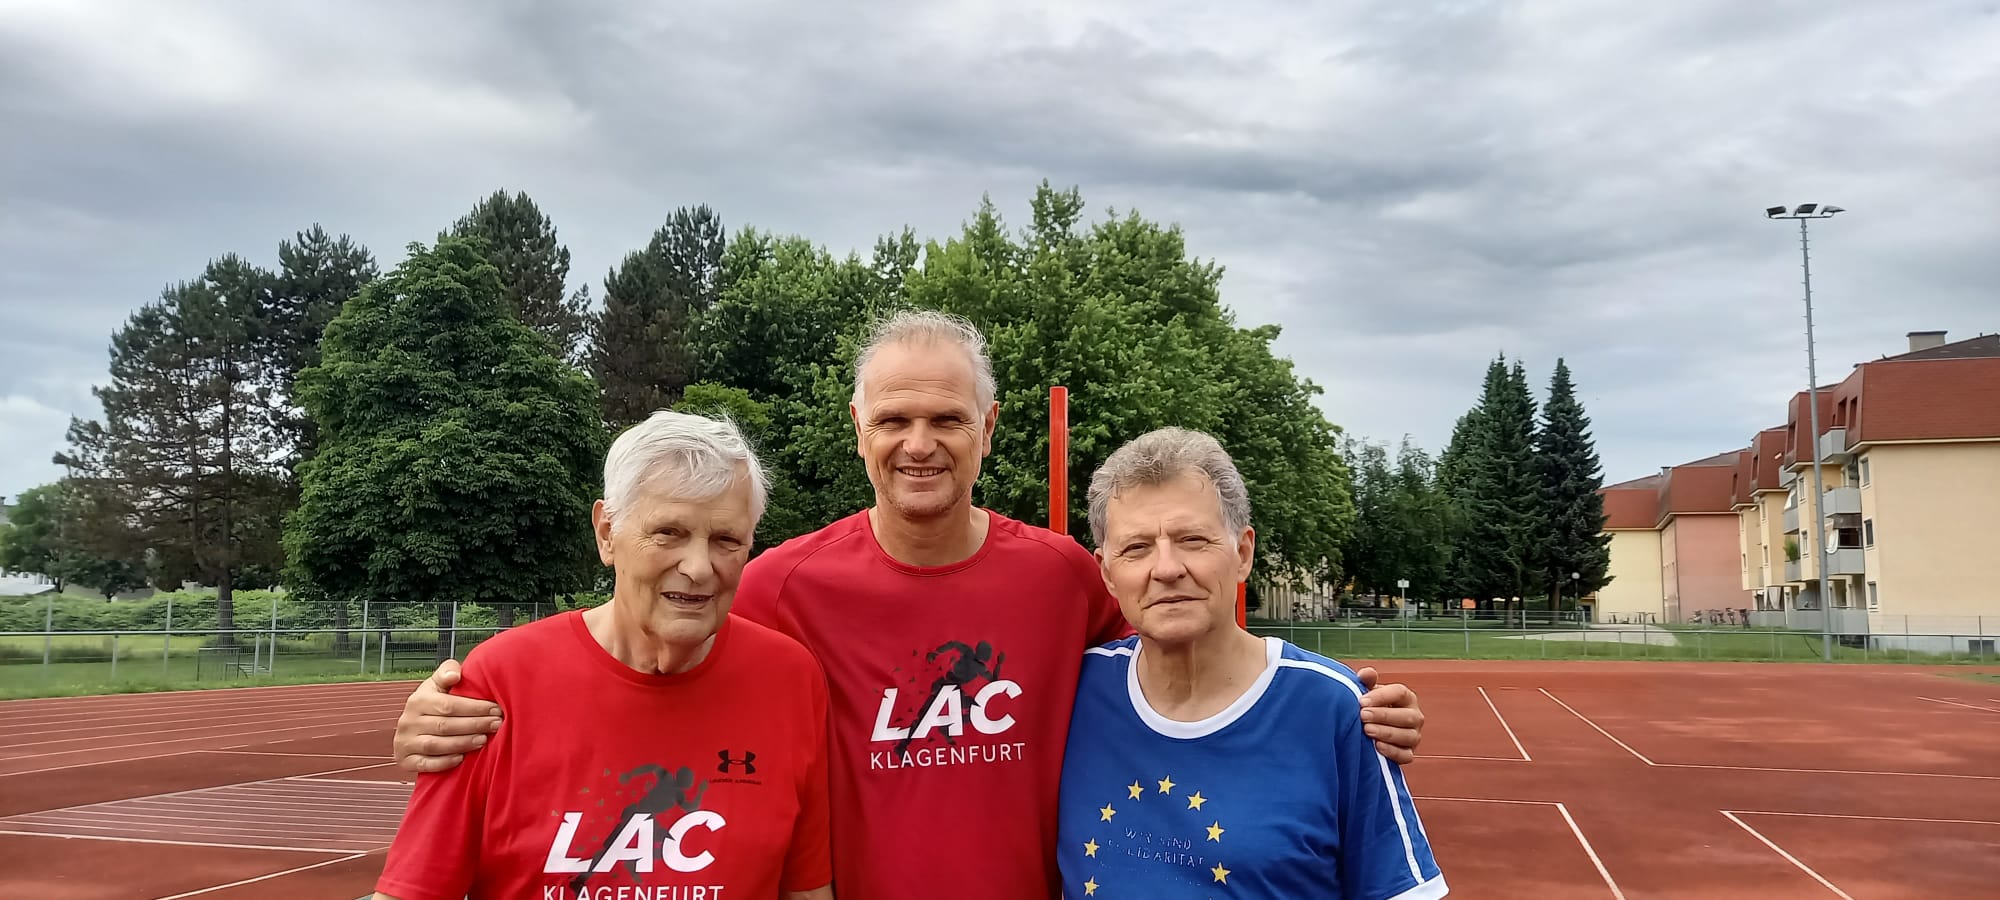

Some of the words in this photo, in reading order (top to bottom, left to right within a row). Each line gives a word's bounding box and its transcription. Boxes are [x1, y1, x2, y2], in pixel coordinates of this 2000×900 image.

[871, 680, 1023, 742] LAC
[870, 743, 1025, 770] KLAGENFURT
[543, 810, 727, 873] LAC
[1125, 826, 1152, 844] WR
[543, 885, 724, 900] KLAGENFURT
